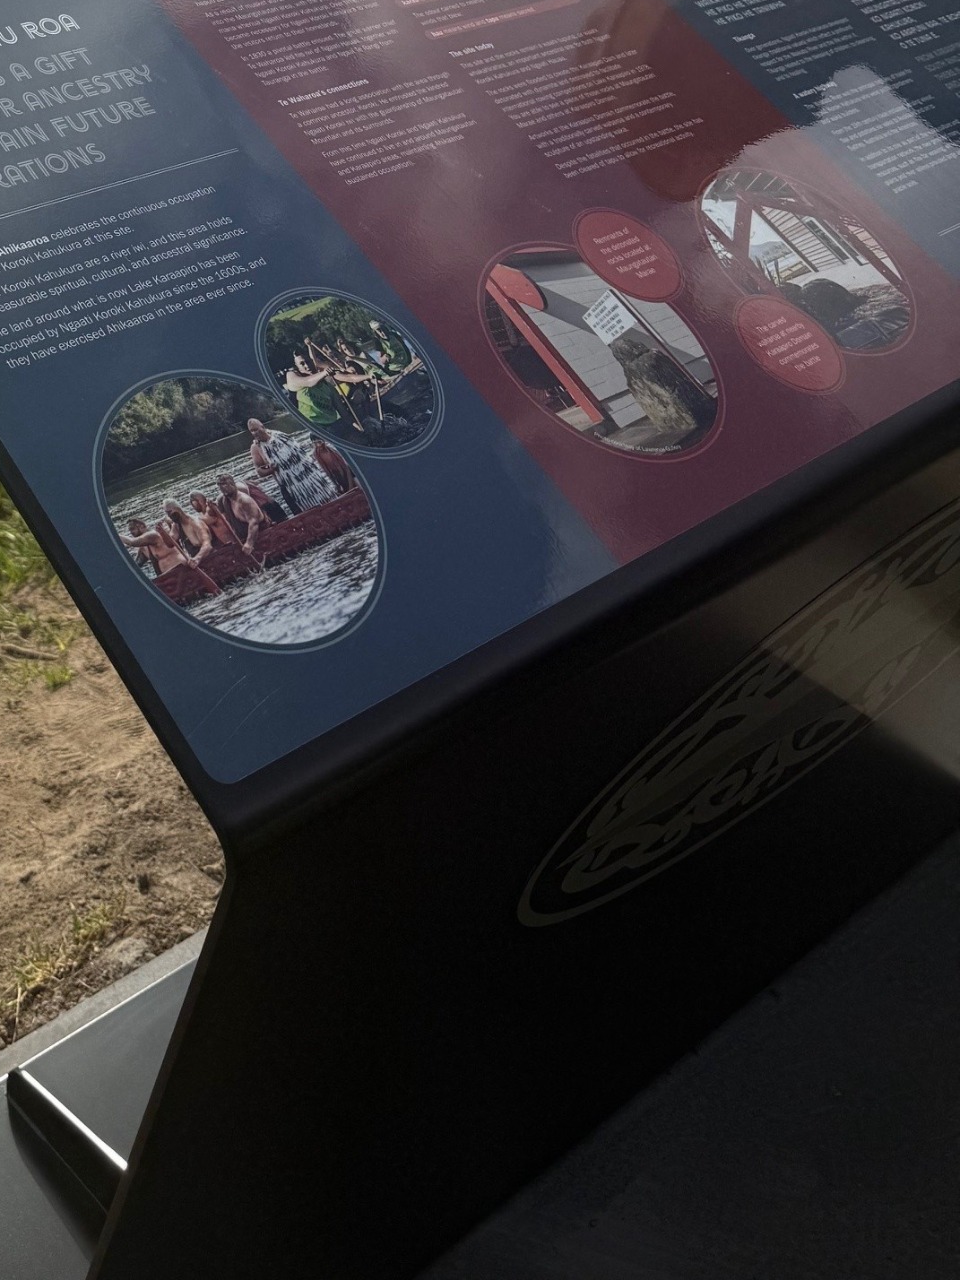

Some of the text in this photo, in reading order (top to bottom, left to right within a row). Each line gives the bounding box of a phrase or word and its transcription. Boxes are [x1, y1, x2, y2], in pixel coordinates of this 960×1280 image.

[20, 14, 81, 39] ROA
[9, 63, 32, 82] A
[34, 47, 92, 75] GIFT
[448, 50, 464, 58] The
[474, 43, 494, 51] today
[22, 64, 153, 111] ANCESTRY
[277, 79, 369, 107] Te Waharoa's connections
[49, 96, 156, 138] FUTURE
[50, 220, 101, 240] celebrates
[99, 215, 117, 226] the
[117, 201, 168, 220] continuous
[168, 186, 216, 205] occupation
[0, 256, 35, 272] Koroki
[33, 241, 82, 261] Kahukura
[82, 237, 95, 246] at
[93, 232, 114, 242] this
[113, 226, 134, 237] site.
[0, 277, 36, 294] Koroki
[34, 263, 84, 283] Kahukura
[84, 257, 101, 268] are
[110, 247, 131, 260] river
[131, 242, 150, 253] iwi,
[149, 235, 168, 248] and
[167, 231, 186, 242] this
[186, 224, 208, 236] area
[206, 216, 233, 229] holds
[48, 276, 92, 296] spiritual,
[91, 263, 131, 282] cultural,
[127, 256, 150, 269] and
[150, 242, 194, 263] ancestral
[192, 228, 248, 249] significance.
[8, 317, 34, 332] land
[34, 305, 71, 324] around
[70, 297, 97, 312] what
[96, 294, 108, 303] is
[107, 288, 128, 300] now
[127, 280, 153, 293] Lake
[152, 265, 198, 285] Karaapiro
[197, 259, 217, 270] has
[215, 251, 240, 264] been
[44, 328, 59, 338] by
[58, 314, 94, 333] Ngaati
[92, 303, 126, 322] Koroki
[124, 289, 173, 310] Kahukura
[172, 281, 198, 295] since
[197, 275, 215, 286] the
[215, 265, 249, 280] 1600s,
[248, 256, 267, 269] and
[6, 279, 254, 369] they have exercised Ahikaaroa in the area ever since.
